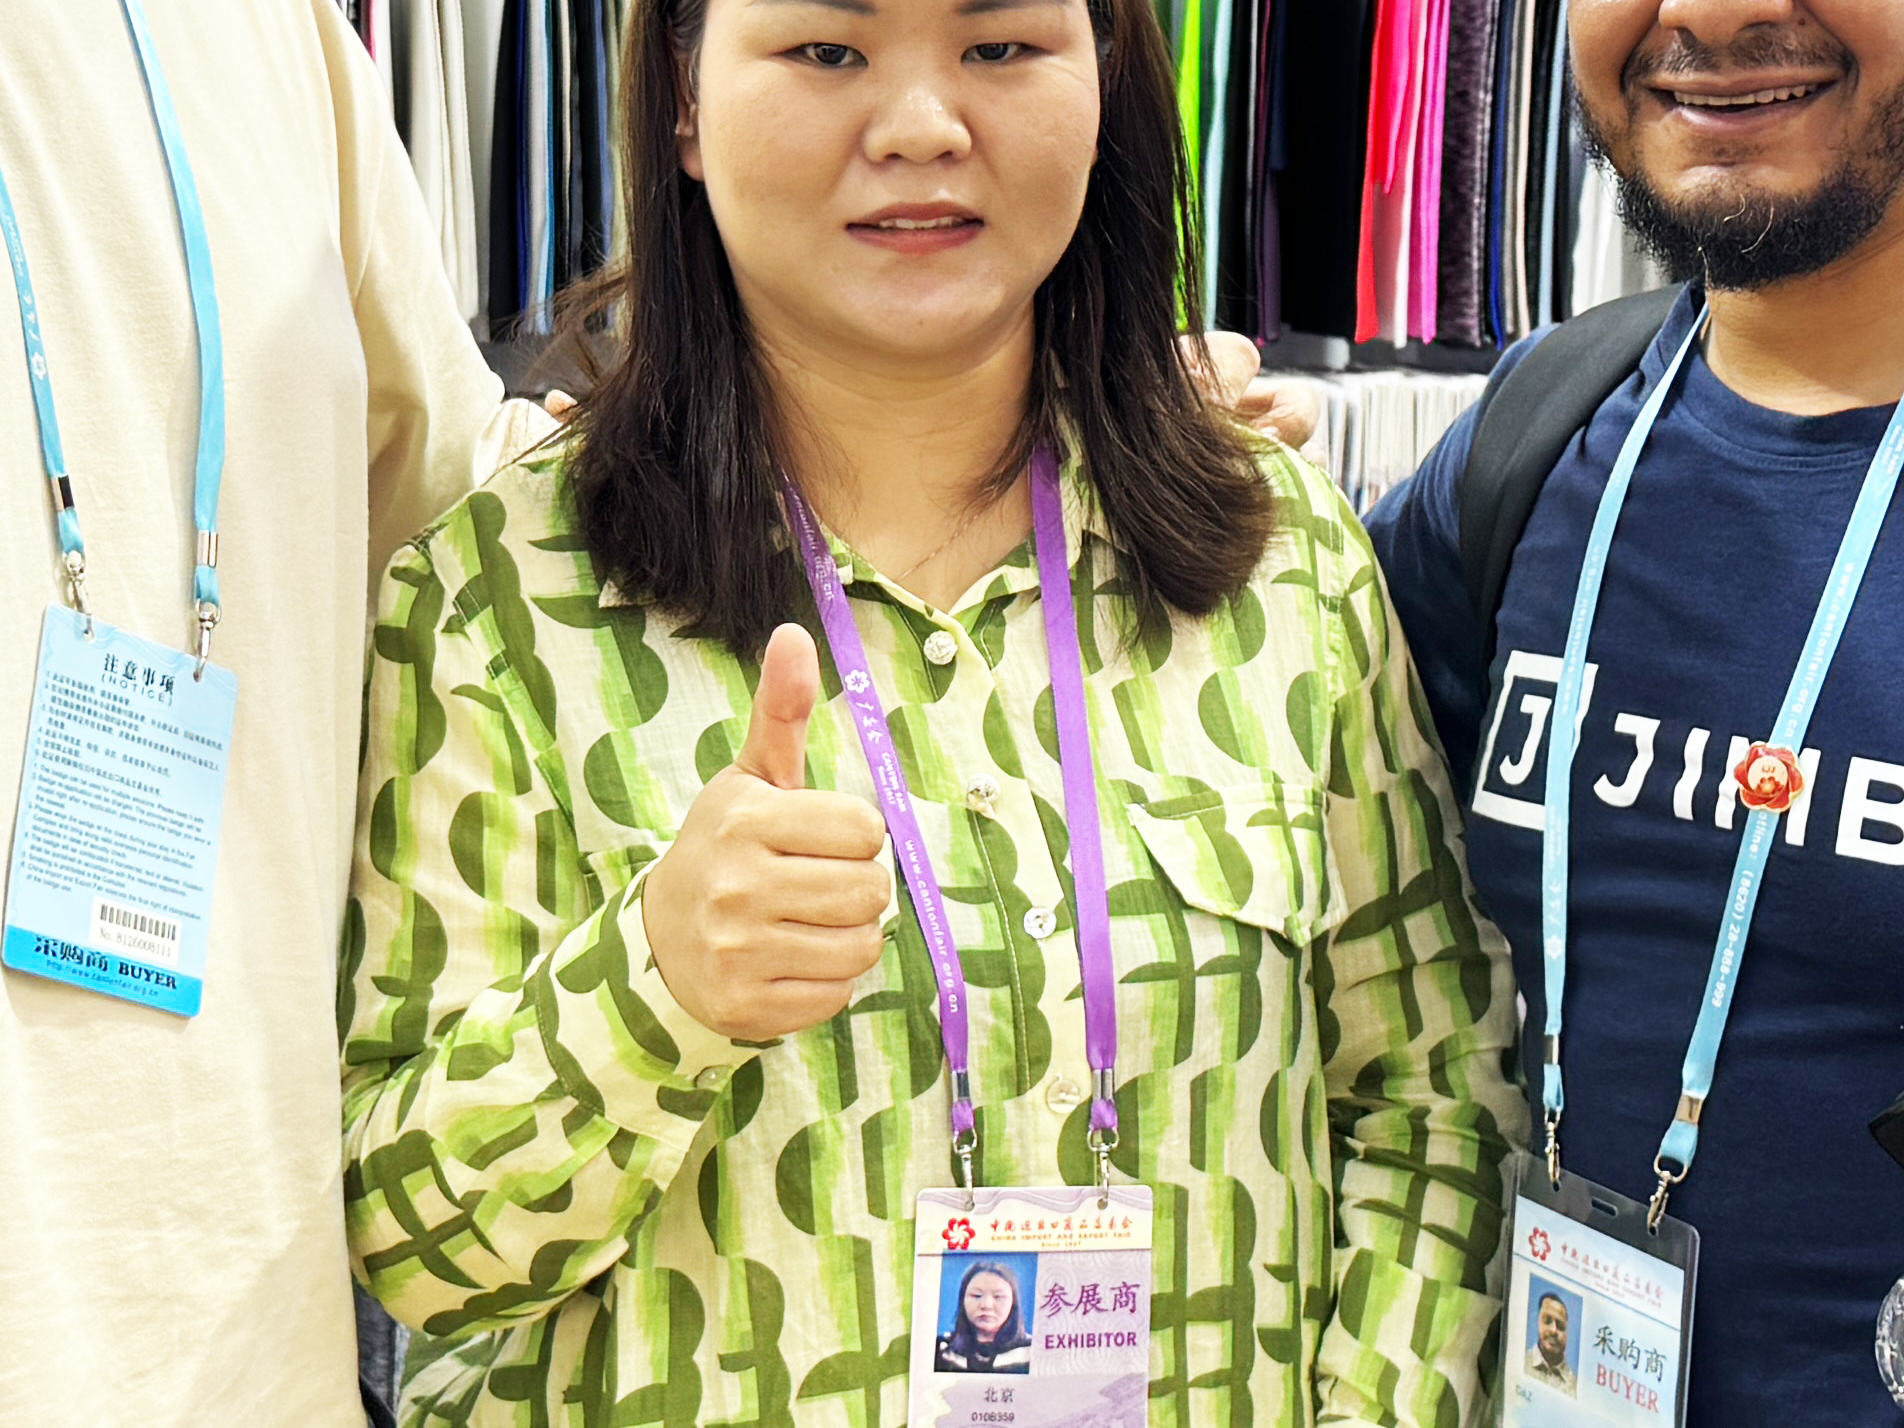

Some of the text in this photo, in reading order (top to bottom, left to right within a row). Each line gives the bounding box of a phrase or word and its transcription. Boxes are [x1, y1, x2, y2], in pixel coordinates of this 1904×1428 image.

[1783, 562, 1856, 738] www.cantonfair.org.cn
[1706, 868, 1756, 1009] (8620) 28-888-999
[118, 962, 177, 990] BUYER
[1040, 1281, 1140, 1318] 参展商
[1045, 1333, 1137, 1350] EXHIBITOR
[1594, 1325, 1666, 1383] 采购商
[984, 1387, 1015, 1403] 北京
[1596, 1362, 1659, 1414] BUYER
